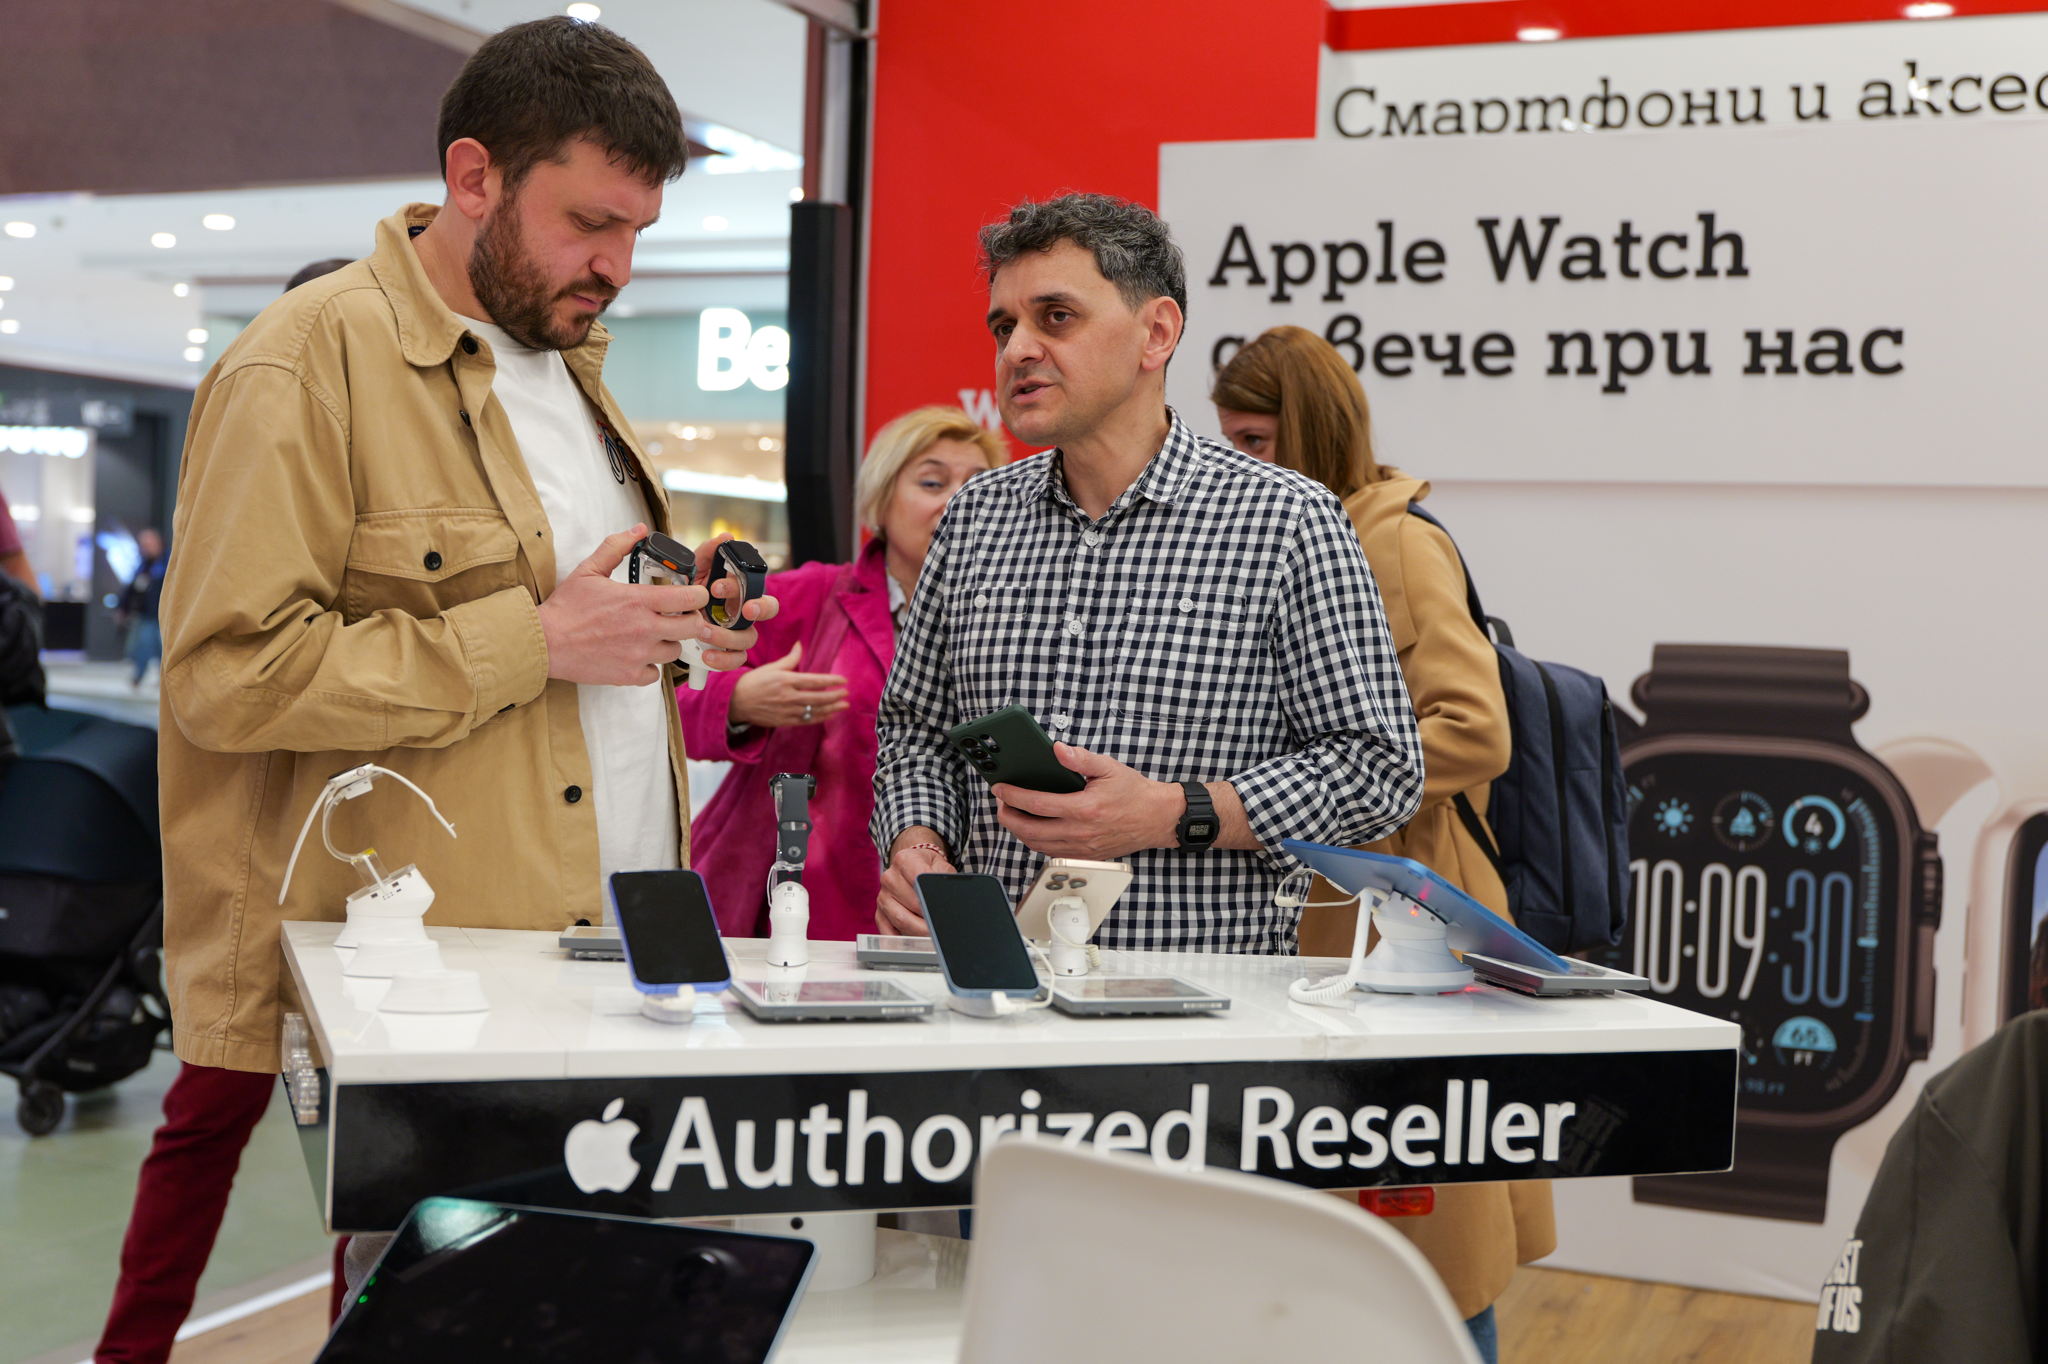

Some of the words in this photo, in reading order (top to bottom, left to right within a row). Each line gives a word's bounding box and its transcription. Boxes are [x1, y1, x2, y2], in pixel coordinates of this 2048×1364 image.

[1789, 83, 1830, 122] и
[1208, 221, 1447, 304] Apple
[1476, 211, 1750, 284] Watch
[1546, 329, 1712, 395] при
[1742, 326, 1905, 376] нас
[1239, 1078, 1577, 1172] Reseller
